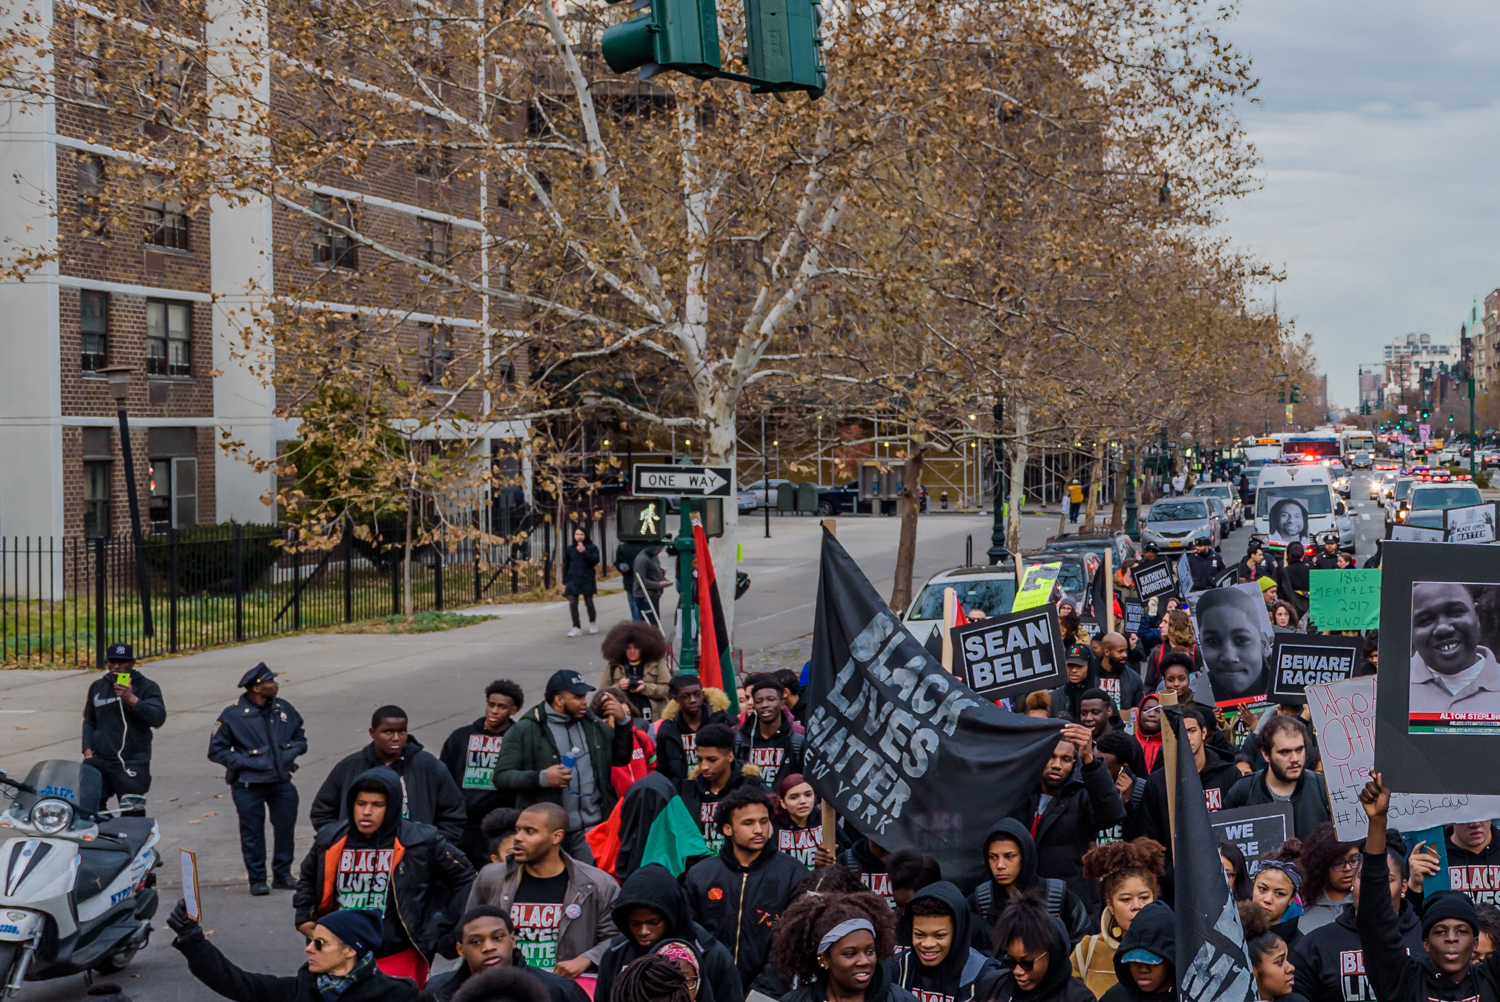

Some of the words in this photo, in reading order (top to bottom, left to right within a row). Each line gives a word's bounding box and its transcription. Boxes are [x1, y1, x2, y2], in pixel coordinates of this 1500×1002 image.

[648, 474, 676, 487] ONE
[689, 475, 718, 488] WAY
[1139, 567, 1168, 586] KATHRYN
[1339, 571, 1368, 584] 1865
[1141, 576, 1172, 596] JOHNSTON
[1313, 586, 1382, 598] MENTALI
[1337, 600, 1370, 613] 2017
[1310, 616, 1379, 629] ECHNOLO
[965, 619, 1051, 662] SEAN
[971, 649, 1053, 688] BELL
[1280, 653, 1350, 672] BEWARE
[850, 611, 980, 737] BLACK
[1282, 669, 1346, 685] RACISM
[826, 656, 940, 778] LIVES
[1440, 712, 1466, 720] ALTON
[468, 735, 502, 752] BLAC
[467, 752, 499, 768] LIVE
[806, 705, 912, 819] MATTER
[465, 768, 495, 781] MATT
[803, 748, 831, 781] EW
[835, 781, 894, 835] YORK
[1225, 823, 1253, 840] WE
[1236, 841, 1259, 857] RE
[341, 851, 392, 872] BLACK
[338, 872, 389, 892] LIVES
[111, 886, 132, 906] NYPD
[516, 943, 557, 959] ATTE
[533, 958, 556, 967] YOR
